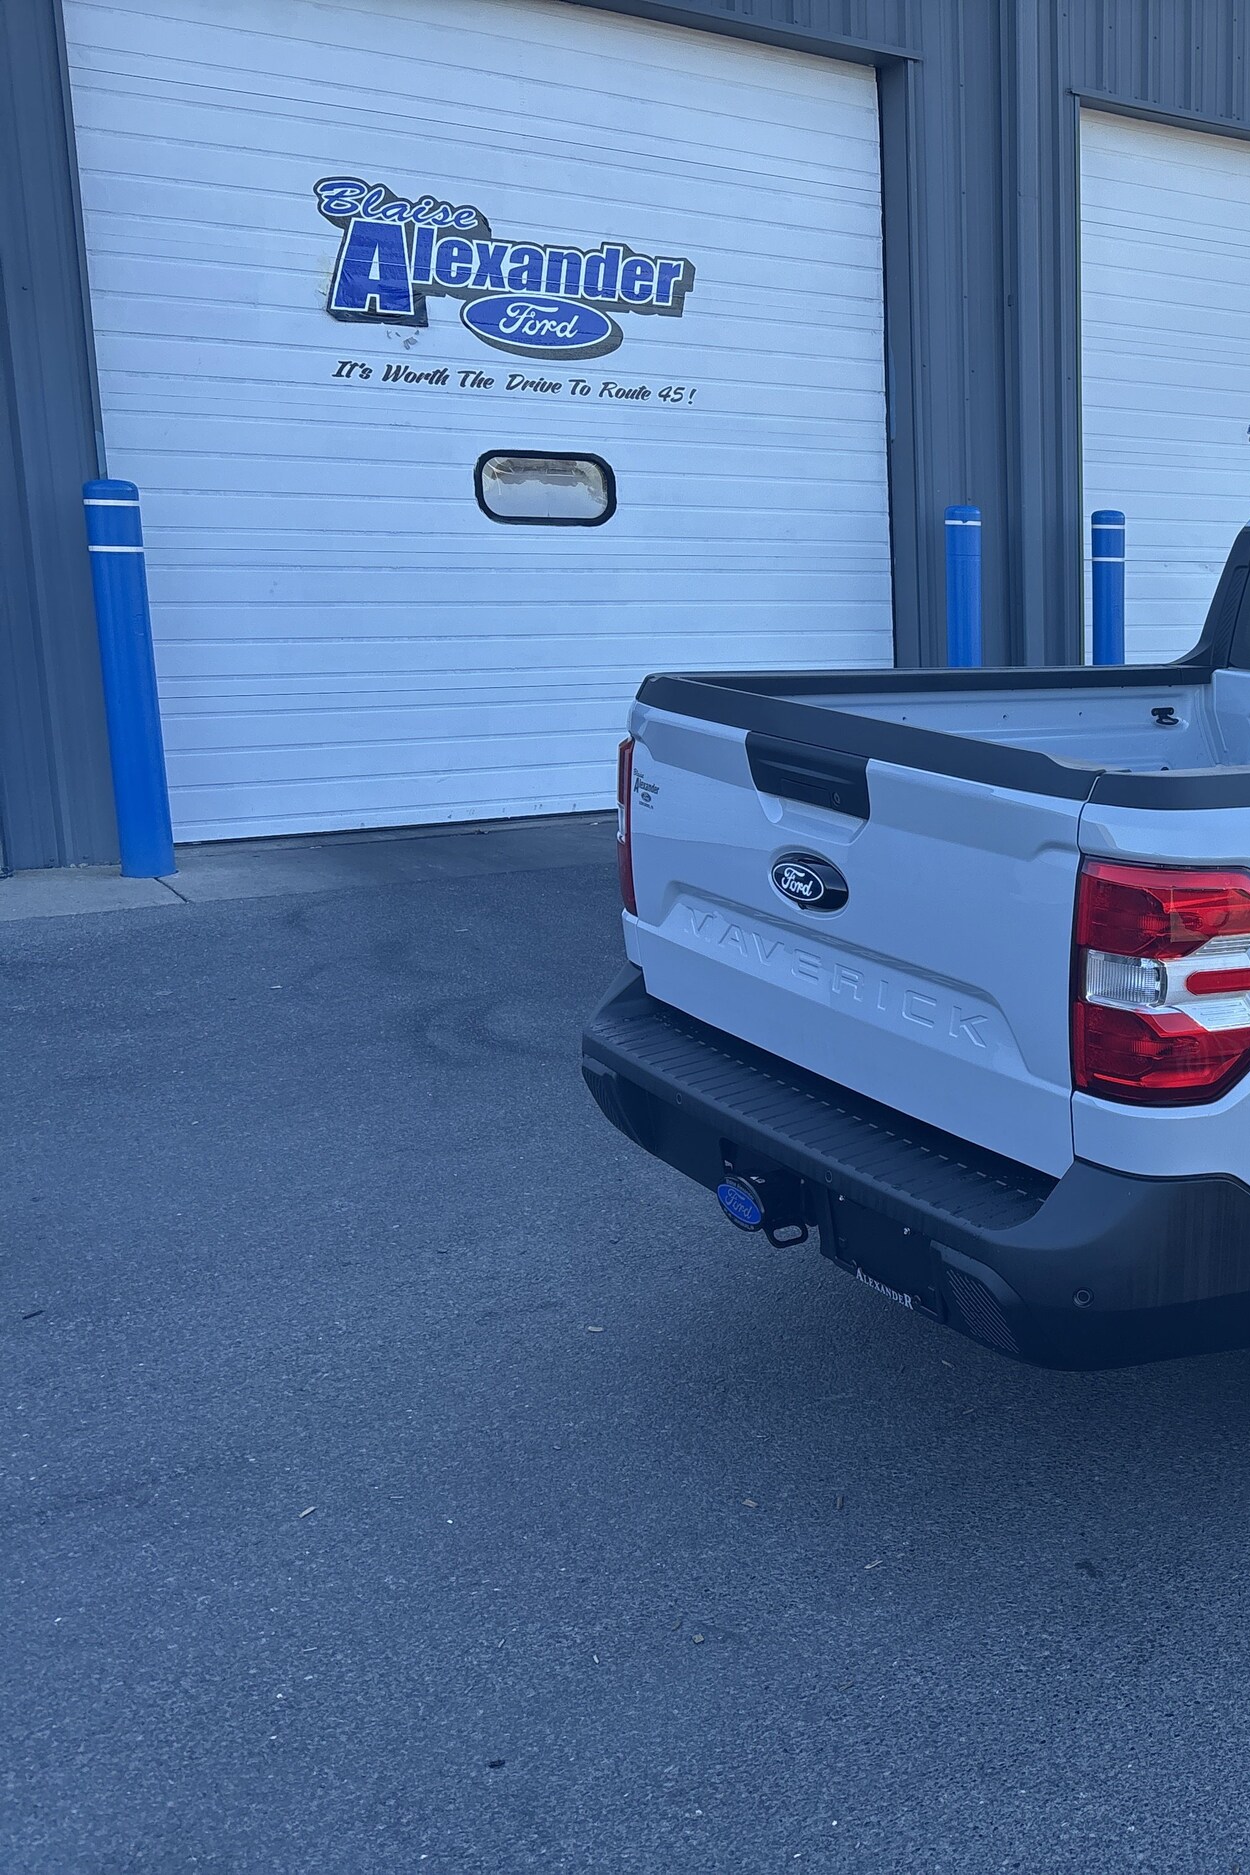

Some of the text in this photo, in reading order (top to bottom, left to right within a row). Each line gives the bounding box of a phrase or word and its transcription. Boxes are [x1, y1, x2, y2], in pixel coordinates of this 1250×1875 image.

[316, 178, 479, 231] Blaise
[331, 217, 685, 315] Alexander
[498, 302, 579, 338] Ford
[331, 360, 373, 380] It's
[381, 363, 450, 386] Worth
[457, 370, 494, 390] The
[505, 373, 562, 394] Drive
[568, 379, 591, 396] To
[598, 381, 651, 401] Route
[781, 867, 814, 897] Ford
[683, 905, 988, 1049] MAVERICK
[724, 1188, 753, 1219] Ford
[856, 1267, 914, 1311] ALEXANDER
